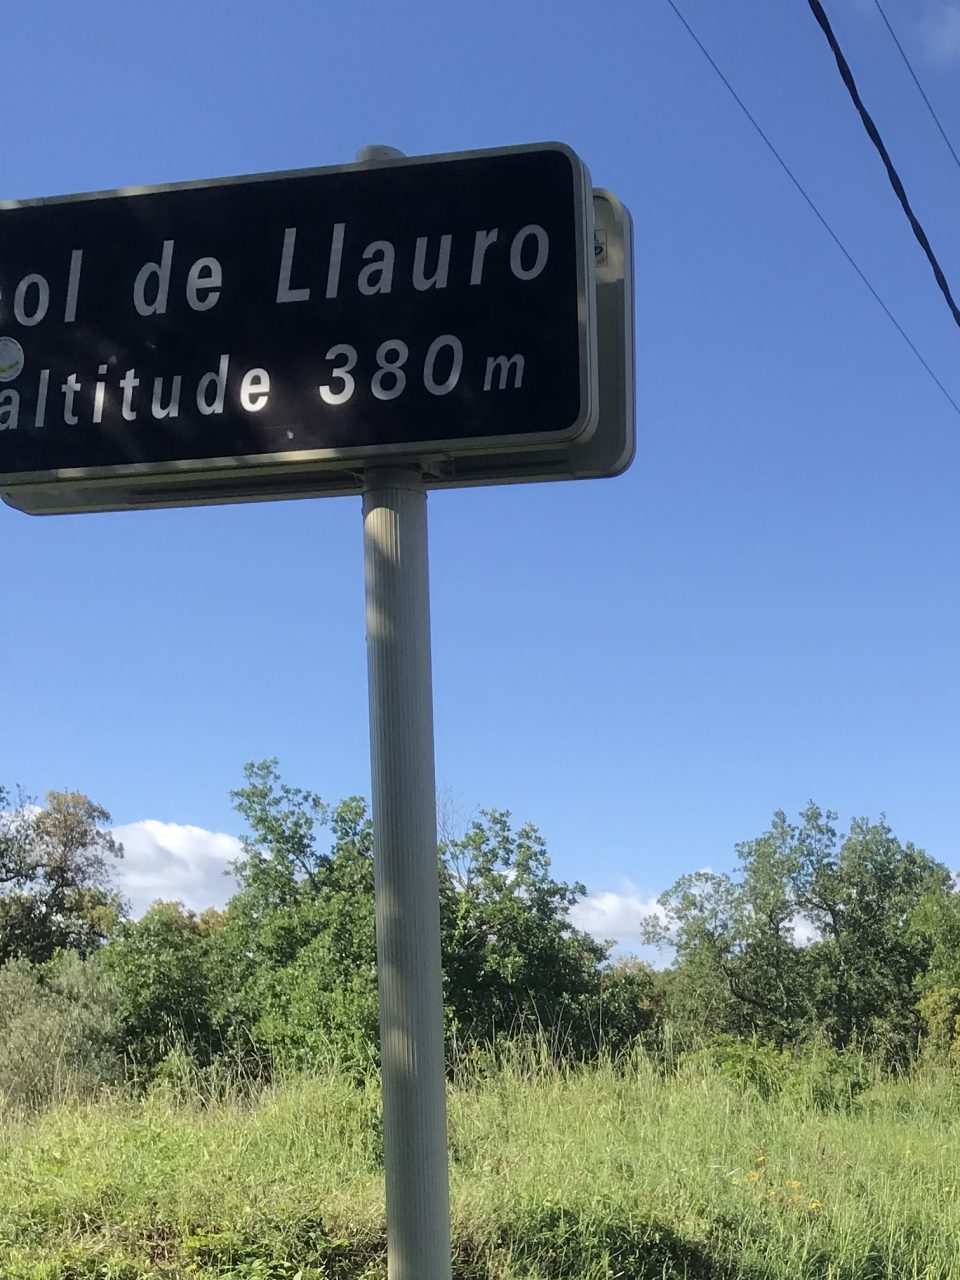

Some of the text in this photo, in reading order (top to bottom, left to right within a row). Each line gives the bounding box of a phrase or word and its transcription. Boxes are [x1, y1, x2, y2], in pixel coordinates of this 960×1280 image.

[0, 249, 83, 327] ol
[133, 240, 223, 317] de
[276, 223, 550, 304] Llauro
[0, 335, 526, 431] altitude 380 m
